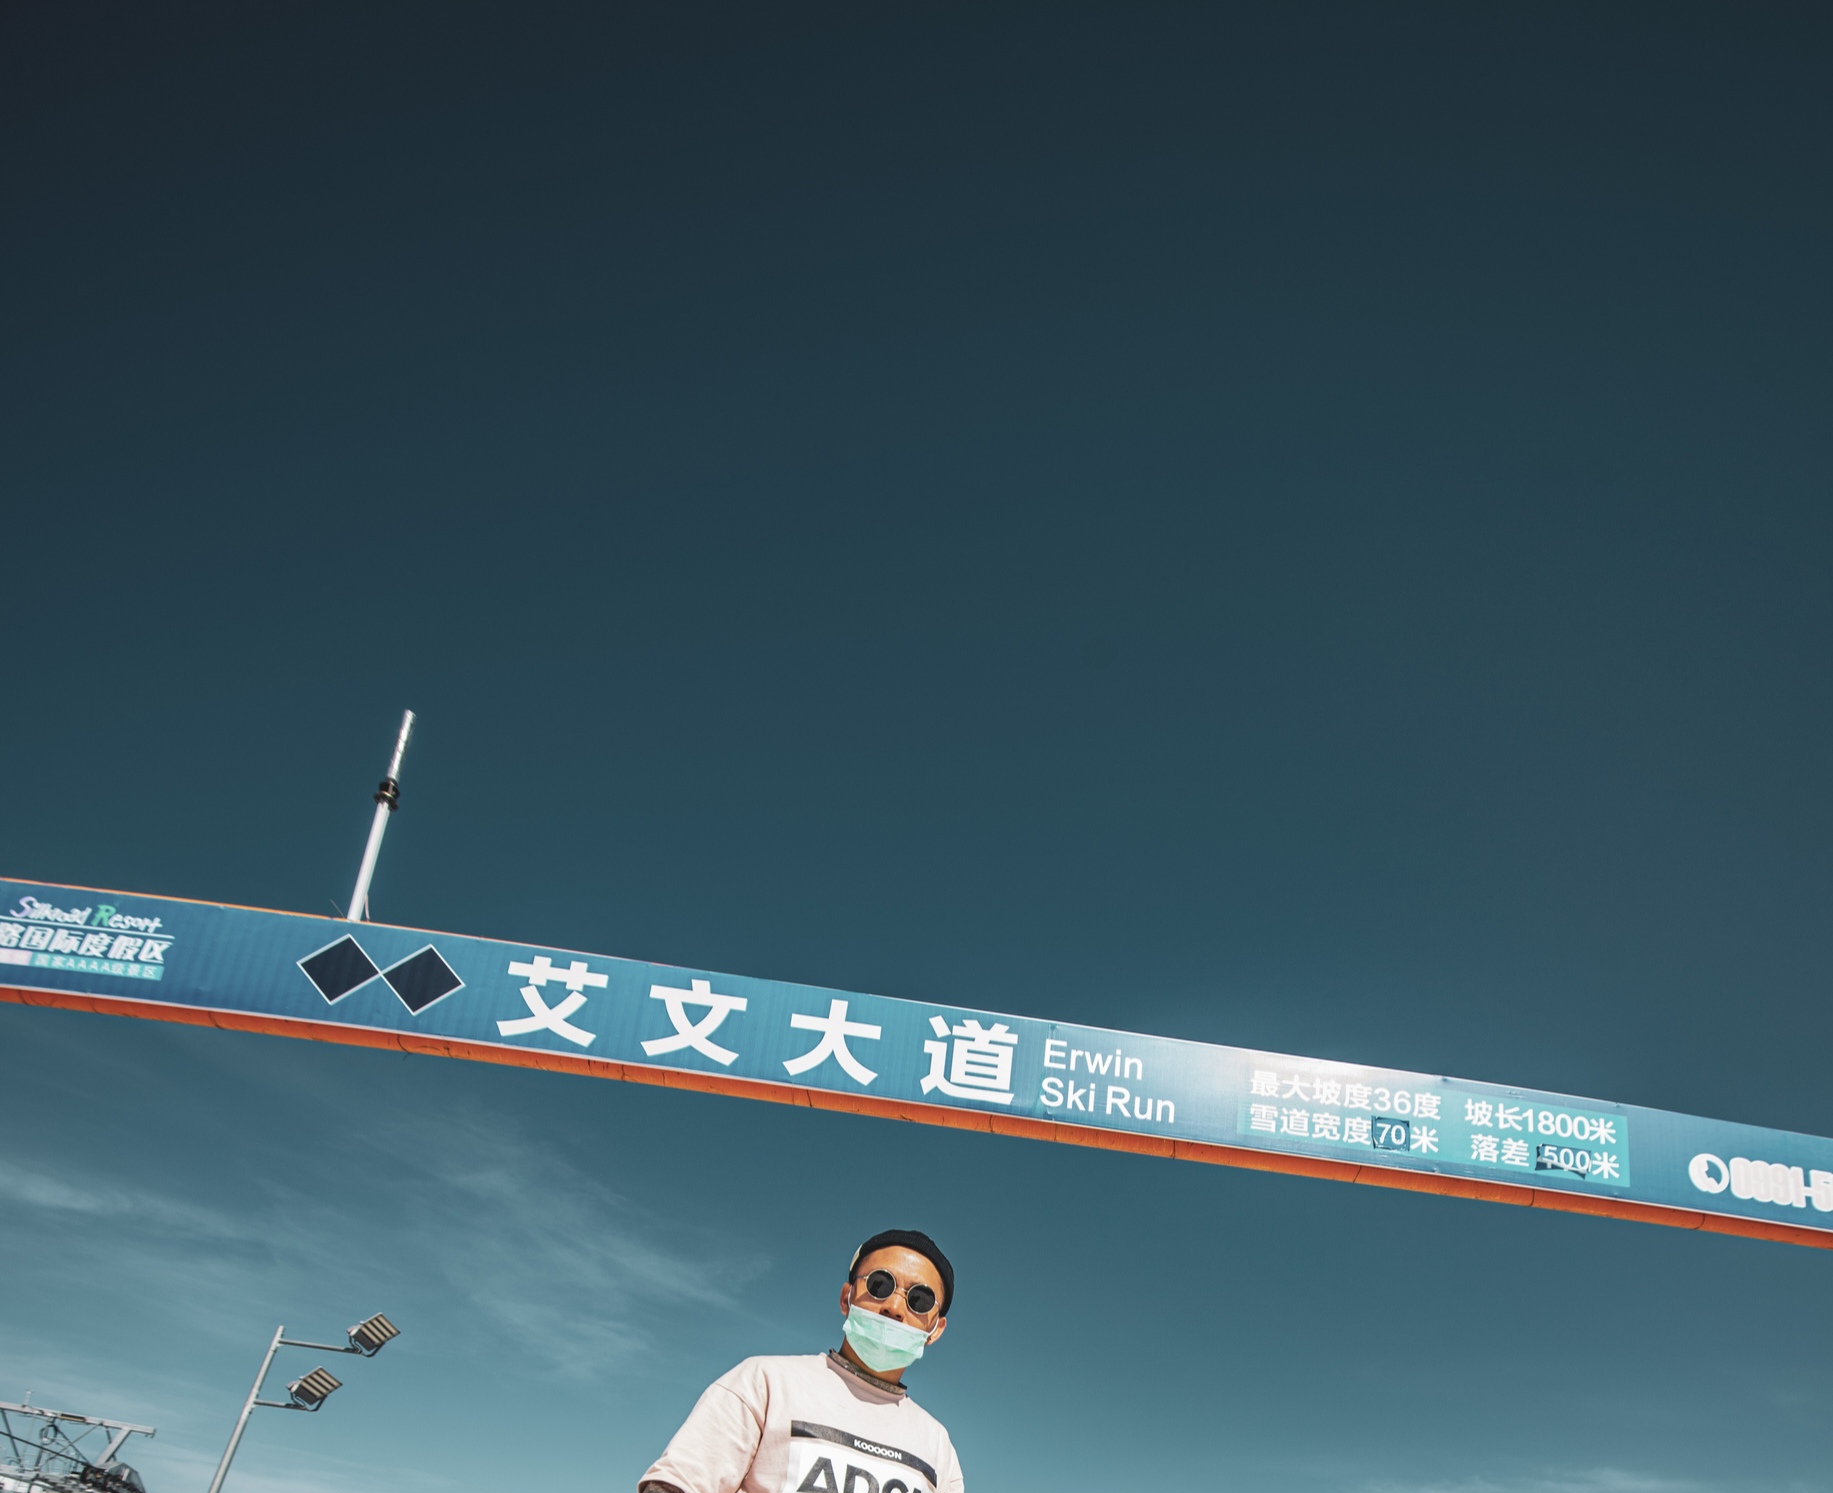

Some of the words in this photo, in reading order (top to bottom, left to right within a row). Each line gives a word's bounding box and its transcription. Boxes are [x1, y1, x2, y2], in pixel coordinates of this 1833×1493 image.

[91, 905, 163, 933] Resort
[496, 955, 1018, 1105] 艾文大道
[1044, 1038, 1143, 1080] Erwin
[1040, 1077, 1096, 1113] Ski
[1105, 1085, 1175, 1124] Run
[1250, 1070, 1441, 1120] 最大坡度36度
[1464, 1098, 1616, 1144] 坡长1800米
[1250, 1103, 1439, 1153] 雪道宽度70米
